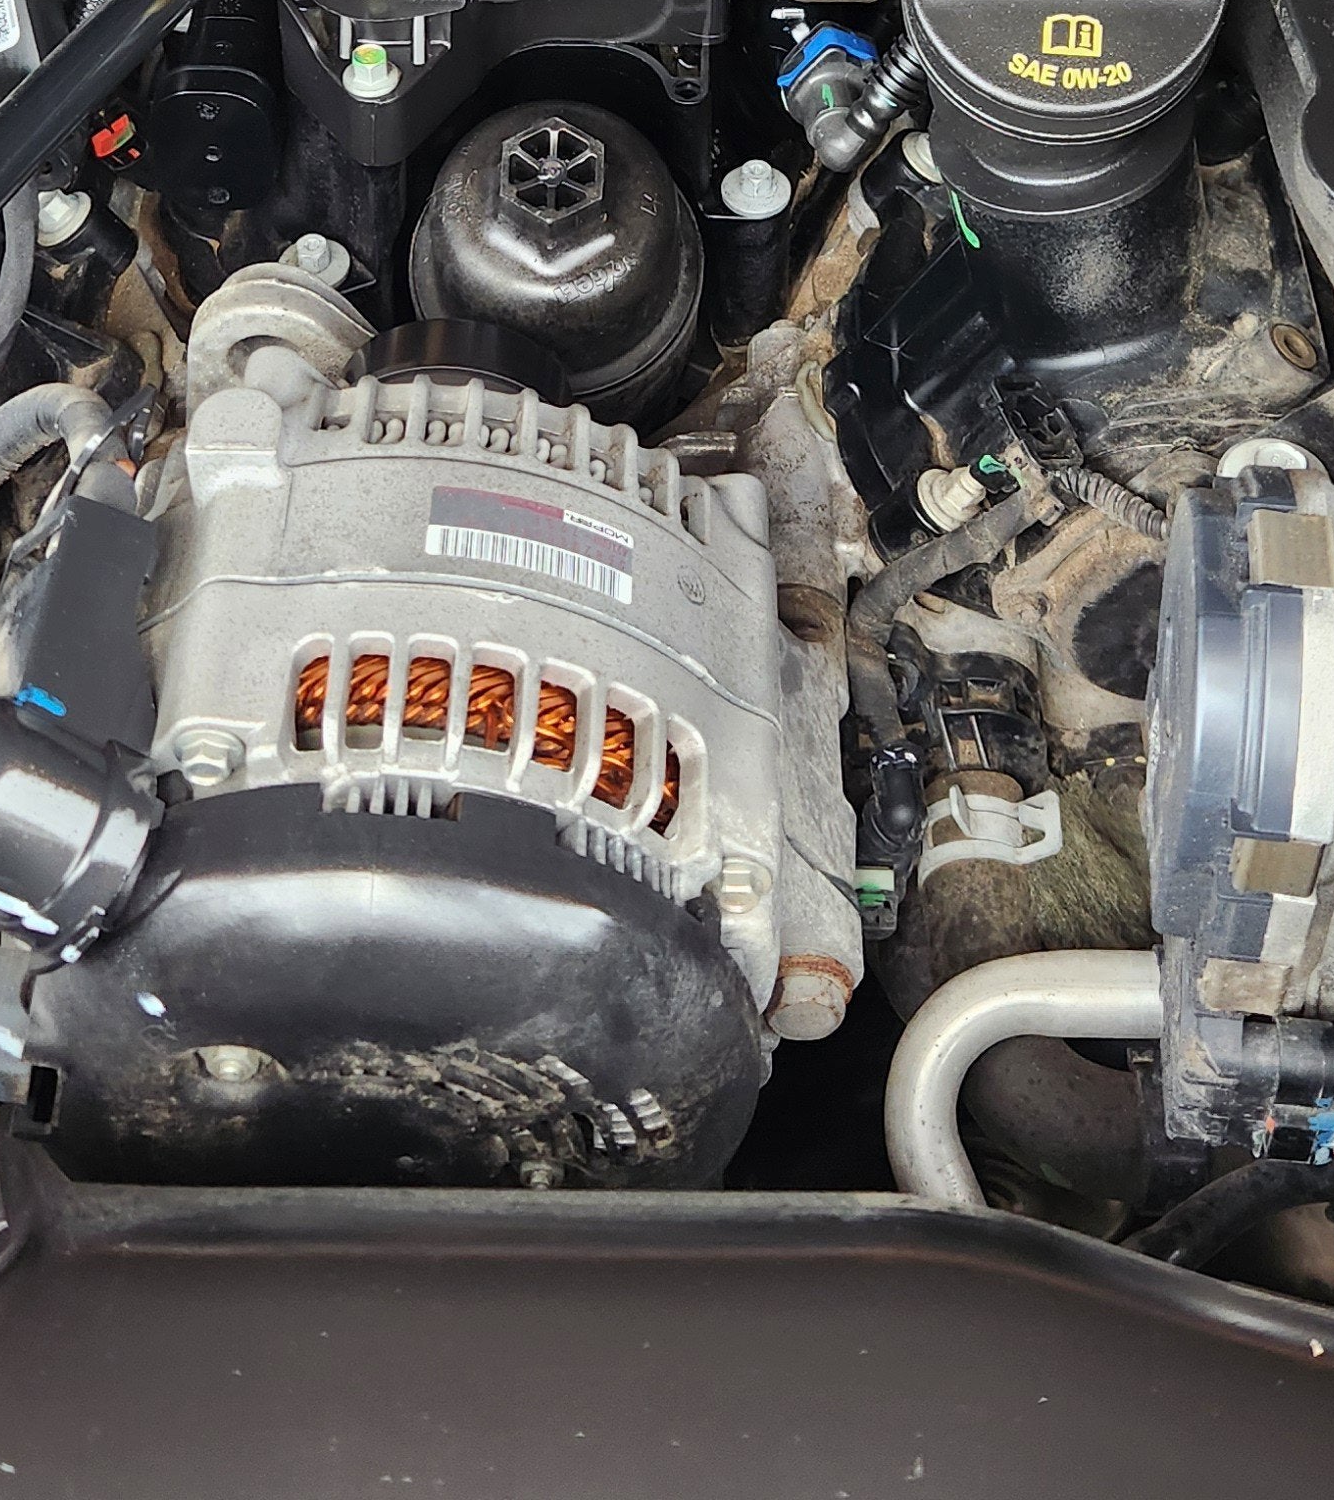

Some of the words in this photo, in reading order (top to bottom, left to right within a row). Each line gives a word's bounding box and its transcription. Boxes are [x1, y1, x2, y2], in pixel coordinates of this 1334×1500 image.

[1008, 53, 1056, 87] SAE
[1062, 62, 1133, 89] 0W-20
[566, 512, 630, 545] MOPAR
